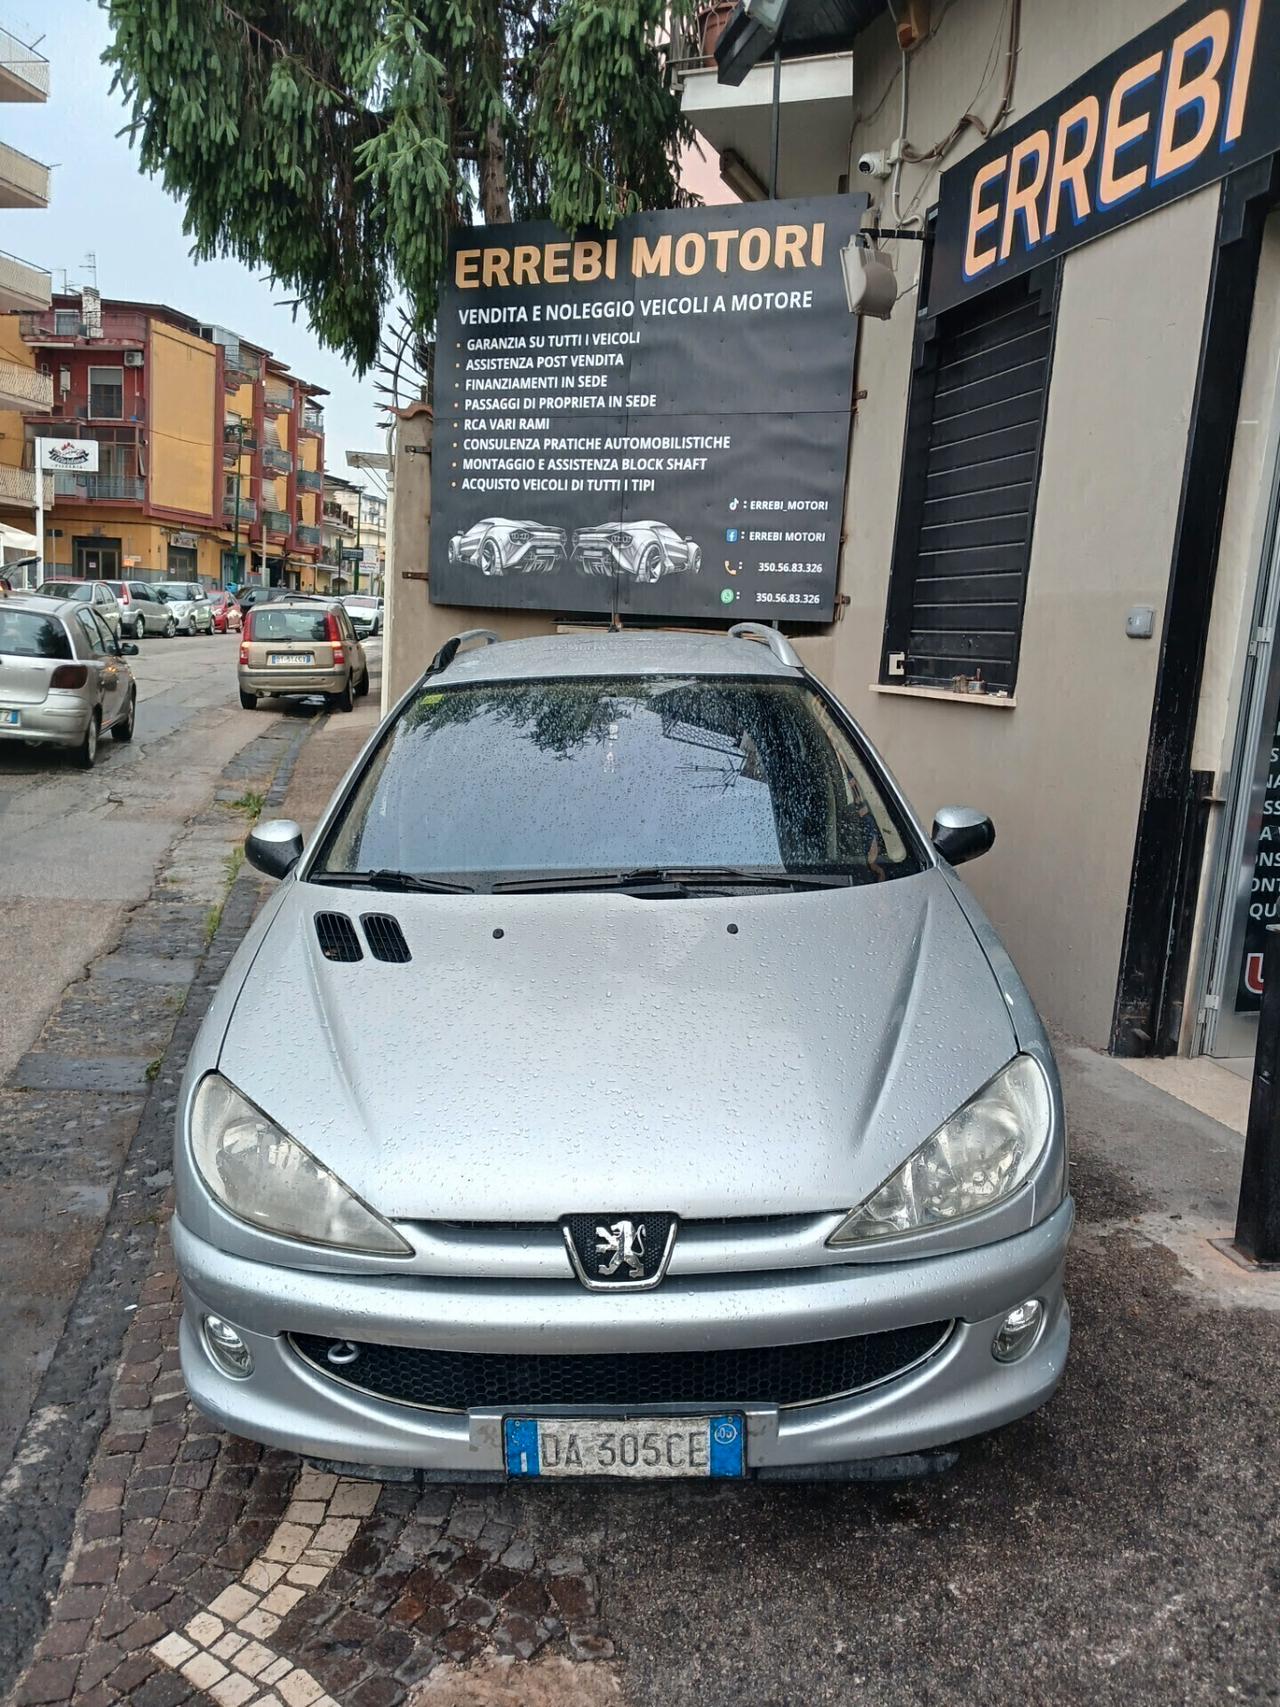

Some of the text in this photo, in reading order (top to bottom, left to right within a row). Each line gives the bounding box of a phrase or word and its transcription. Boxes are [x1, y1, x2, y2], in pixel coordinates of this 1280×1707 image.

[963, 0, 1262, 281] ERREBI
[455, 222, 826, 289] ERREBI MOTORI
[459, 290, 813, 324] VENDITA E NOLEGGIO VEICOLI A MOTORE
[467, 332, 640, 350] GARANZIA SU TUTTI I VEICOLI
[466, 354, 624, 370] ASSISTENZA POST VENDITA
[466, 375, 607, 390] FINANZIAMENTI IN SEDE
[465, 395, 656, 410] PASSAGGI DI PROPRIETA IN SEDE
[465, 418, 549, 430] RCA VARI RAMI
[464, 436, 730, 450] CONSULENZA PRATICHE AUTOMOBILISTICHE
[463, 458, 707, 470] MONTAGGIO E ASSISTENZA BLOCK SHAFT
[462, 479, 654, 491] ACQUISTO VEICOLI DI TUTTI I TIPI
[751, 501, 828, 511] ERREBI_MOTORI
[750, 532, 782, 541] ERREBI
[785, 532, 825, 541] MOTORI
[759, 563, 822, 572] 350.56.83.326
[756, 593, 819, 603] 350.56.83.326
[541, 1431, 708, 1468] DA 305CE
